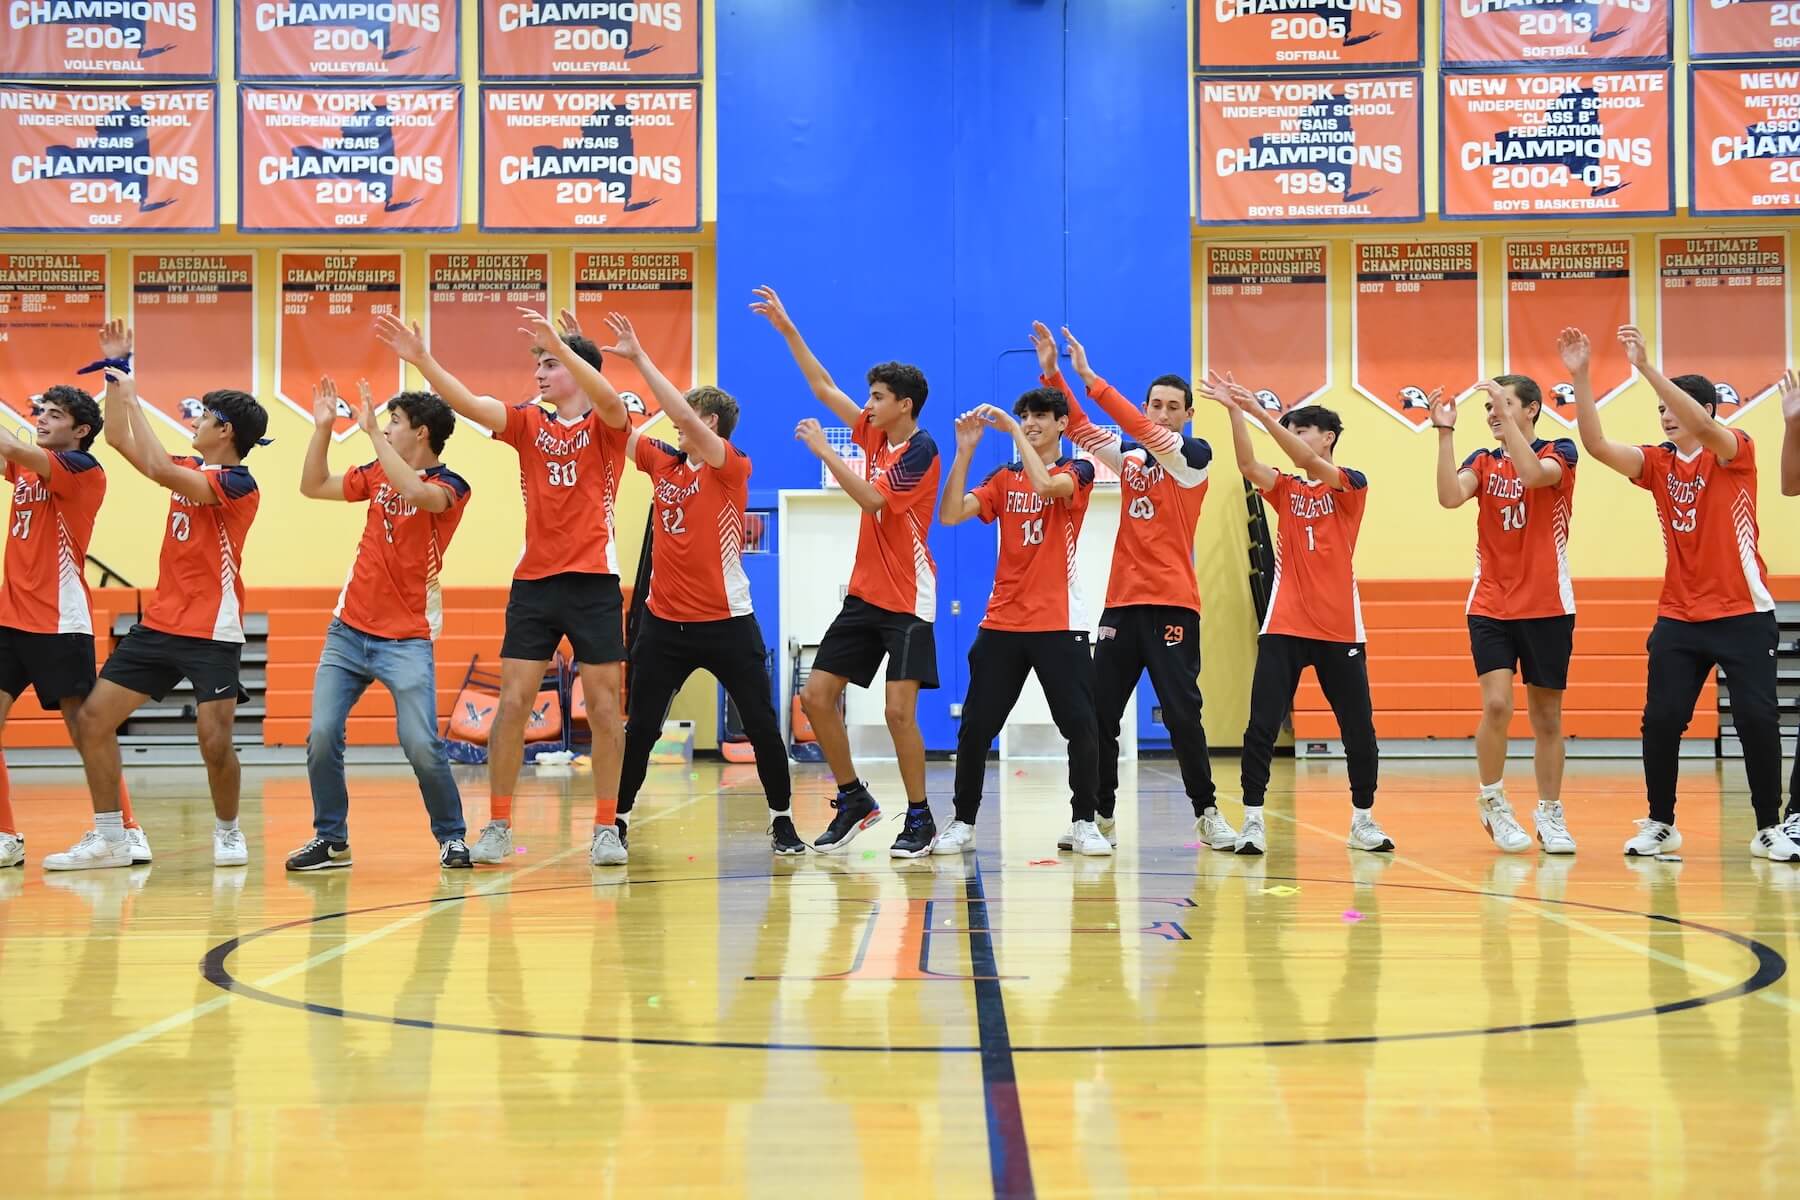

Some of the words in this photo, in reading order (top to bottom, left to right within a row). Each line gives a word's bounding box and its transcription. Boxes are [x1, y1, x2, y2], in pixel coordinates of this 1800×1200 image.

[9, 1, 197, 31] CHAMPIONS
[256, 3, 440, 32] CHAMPIONS
[500, 3, 682, 32] CHAMPIONS
[1270, 17, 1346, 40] 2005
[1519, 13, 1592, 35] 2013
[66, 27, 141, 49] 2002
[313, 29, 384, 50] 2001
[554, 29, 628, 50] 2000
[1276, 50, 1341, 61] SOFTBALL
[1523, 45, 1588, 57] SOFTBALL
[64, 59, 144, 71] VOLLEYBALL
[310, 62, 389, 73] VOLLEYBALL
[552, 62, 631, 72] VOLLEYBALL
[1450, 78, 1507, 96] NEW
[1516, 76, 1582, 94] YORK
[1591, 74, 1664, 92] STATE
[1740, 72, 1799, 89] NEW
[1204, 85, 1261, 102] NEW
[1269, 83, 1335, 101] YORK
[1344, 81, 1413, 99] STATE
[0, 94, 56, 110] NEW
[65, 94, 132, 110] YORK
[140, 93, 209, 110] STATE
[247, 93, 304, 111] NEW
[312, 94, 377, 111] YORK
[386, 93, 454, 111] STATE
[489, 94, 545, 110] NEW
[553, 94, 617, 110] YORK
[625, 93, 692, 110] STATE
[1468, 98, 1576, 112] INDEPENDENT
[1581, 97, 1644, 110] SCHOOL
[1745, 94, 1800, 107] METRO
[1222, 105, 1328, 118] INDEPENDENT
[1333, 104, 1395, 116] SCHOOL
[1517, 111, 1573, 124] "CLASS
[1578, 110, 1596, 122] B"
[1767, 107, 1800, 120] LAC
[19, 115, 124, 127] INDEPENDENT
[130, 115, 191, 127] SCHOOL
[266, 115, 371, 127] INDEPENDENT
[375, 115, 436, 127] SCHOOL
[507, 115, 611, 127] INDEPENDENT
[614, 115, 675, 127] SCHOOL
[1280, 119, 1338, 131] NYSAIS
[1756, 120, 1800, 133] ASSO
[1263, 131, 1356, 145] FEDERATION
[1508, 124, 1603, 138] FEDERATION
[76, 137, 134, 149] NYSAIS
[322, 137, 379, 149] NYSAIS
[563, 137, 619, 149] NYSAIS
[1216, 145, 1402, 177] CHAMPIONS
[1461, 138, 1652, 171] CHAMPIONS
[11, 155, 199, 185] CHAMPIONS
[259, 156, 444, 185] CHAMPIONS
[500, 156, 682, 185] CHAMPIONS
[1492, 165, 1621, 189] 2004-05
[1274, 172, 1346, 194] 1993
[69, 182, 141, 203] 2014
[316, 182, 387, 203] 2013
[556, 182, 626, 203] 2012
[1752, 194, 1790, 205] BOYS
[1248, 206, 1284, 216] BOYS
[1288, 204, 1371, 215] BASKETBALL
[1493, 200, 1529, 211] BOYS
[1535, 198, 1620, 210] BASKETBALL
[89, 215, 122, 225] GOLF
[335, 214, 368, 225] GOLF
[575, 214, 607, 225] GOLF
[1362, 245, 1399, 258] GIRLS
[1407, 244, 1472, 257] LACROSSE
[1508, 244, 1543, 256] GIRLS
[1550, 242, 1628, 255] BASKETBALL
[1686, 239, 1759, 252] ULTIMATE
[588, 255, 625, 267] GIRLS
[632, 254, 680, 267] SOCCER
[1211, 249, 1253, 261] CROSS
[1260, 247, 1323, 261] COUNTRY
[1666, 252, 1779, 267] CHAMPIONSHIPS
[9, 256, 81, 268] FOOTBALL
[159, 257, 227, 270] BASEBALL
[325, 256, 358, 269] GOLF
[448, 255, 469, 268] ICE
[476, 255, 529, 268] HOCKEY
[1213, 261, 1321, 275] CHAMPIONSHIPS
[1362, 258, 1472, 272] CHAMPIONSHIPS
[1512, 256, 1624, 270] CHAMPIONSHIPS
[139, 270, 248, 283] CHAMPIONSHIPS
[288, 269, 396, 283] CHAMPIONSHIPS
[435, 268, 542, 281] CHAMPIONSHIPS
[581, 268, 688, 281] CHAMPIONSHIPS
[1360, 283, 1384, 293] 2007
[329, 304, 351, 315] 2014
[546, 460, 577, 486] 30
[1486, 472, 1524, 499] FIELDS
[1006, 490, 1055, 513] FIELDS
[1500, 501, 1527, 531] 10
[1305, 525, 1315, 551] 1
[1164, 624, 1184, 641] 29
